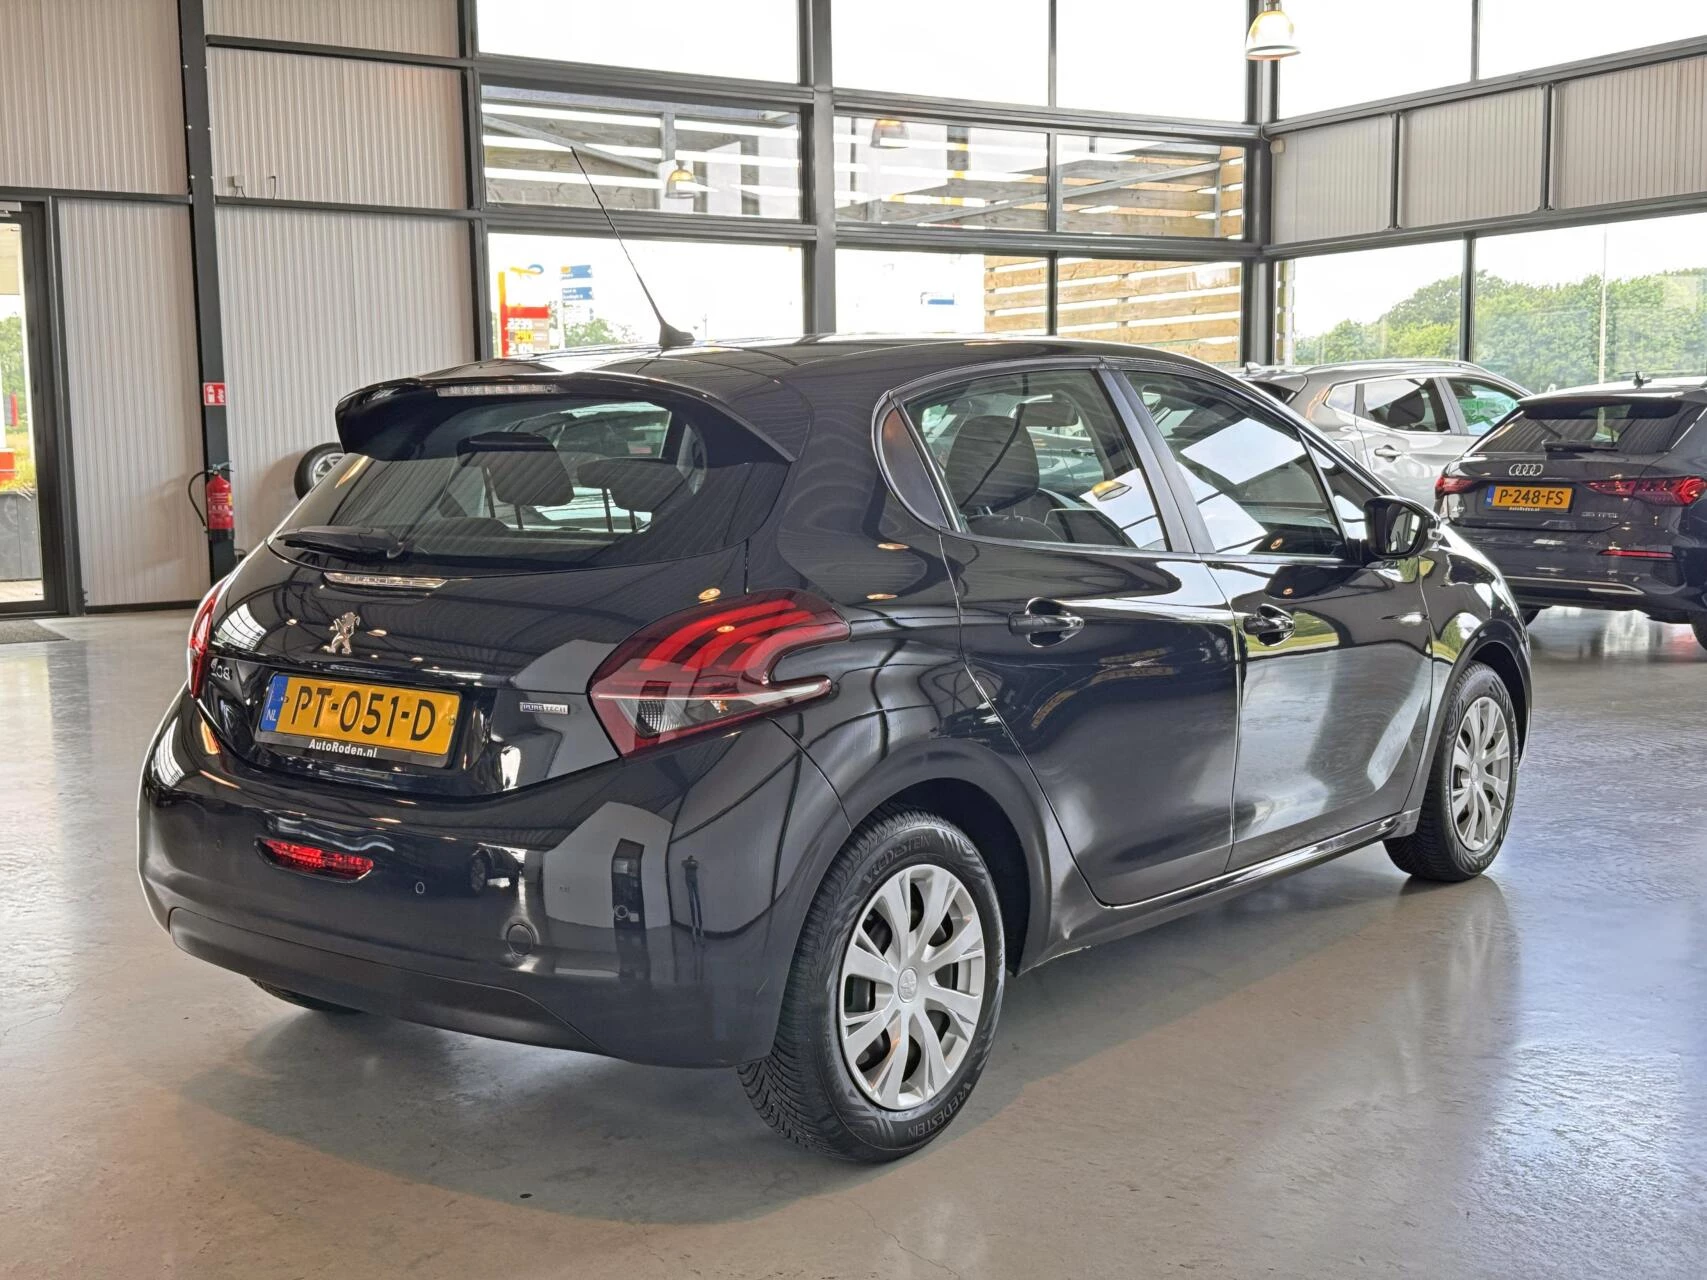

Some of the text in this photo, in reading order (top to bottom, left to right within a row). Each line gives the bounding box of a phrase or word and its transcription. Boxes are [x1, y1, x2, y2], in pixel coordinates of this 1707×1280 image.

[1498, 489, 1565, 506] P-248-FS
[265, 709, 277, 721] NL
[290, 685, 436, 741] PT-051-D
[308, 738, 378, 758] AutoRoden.nl
